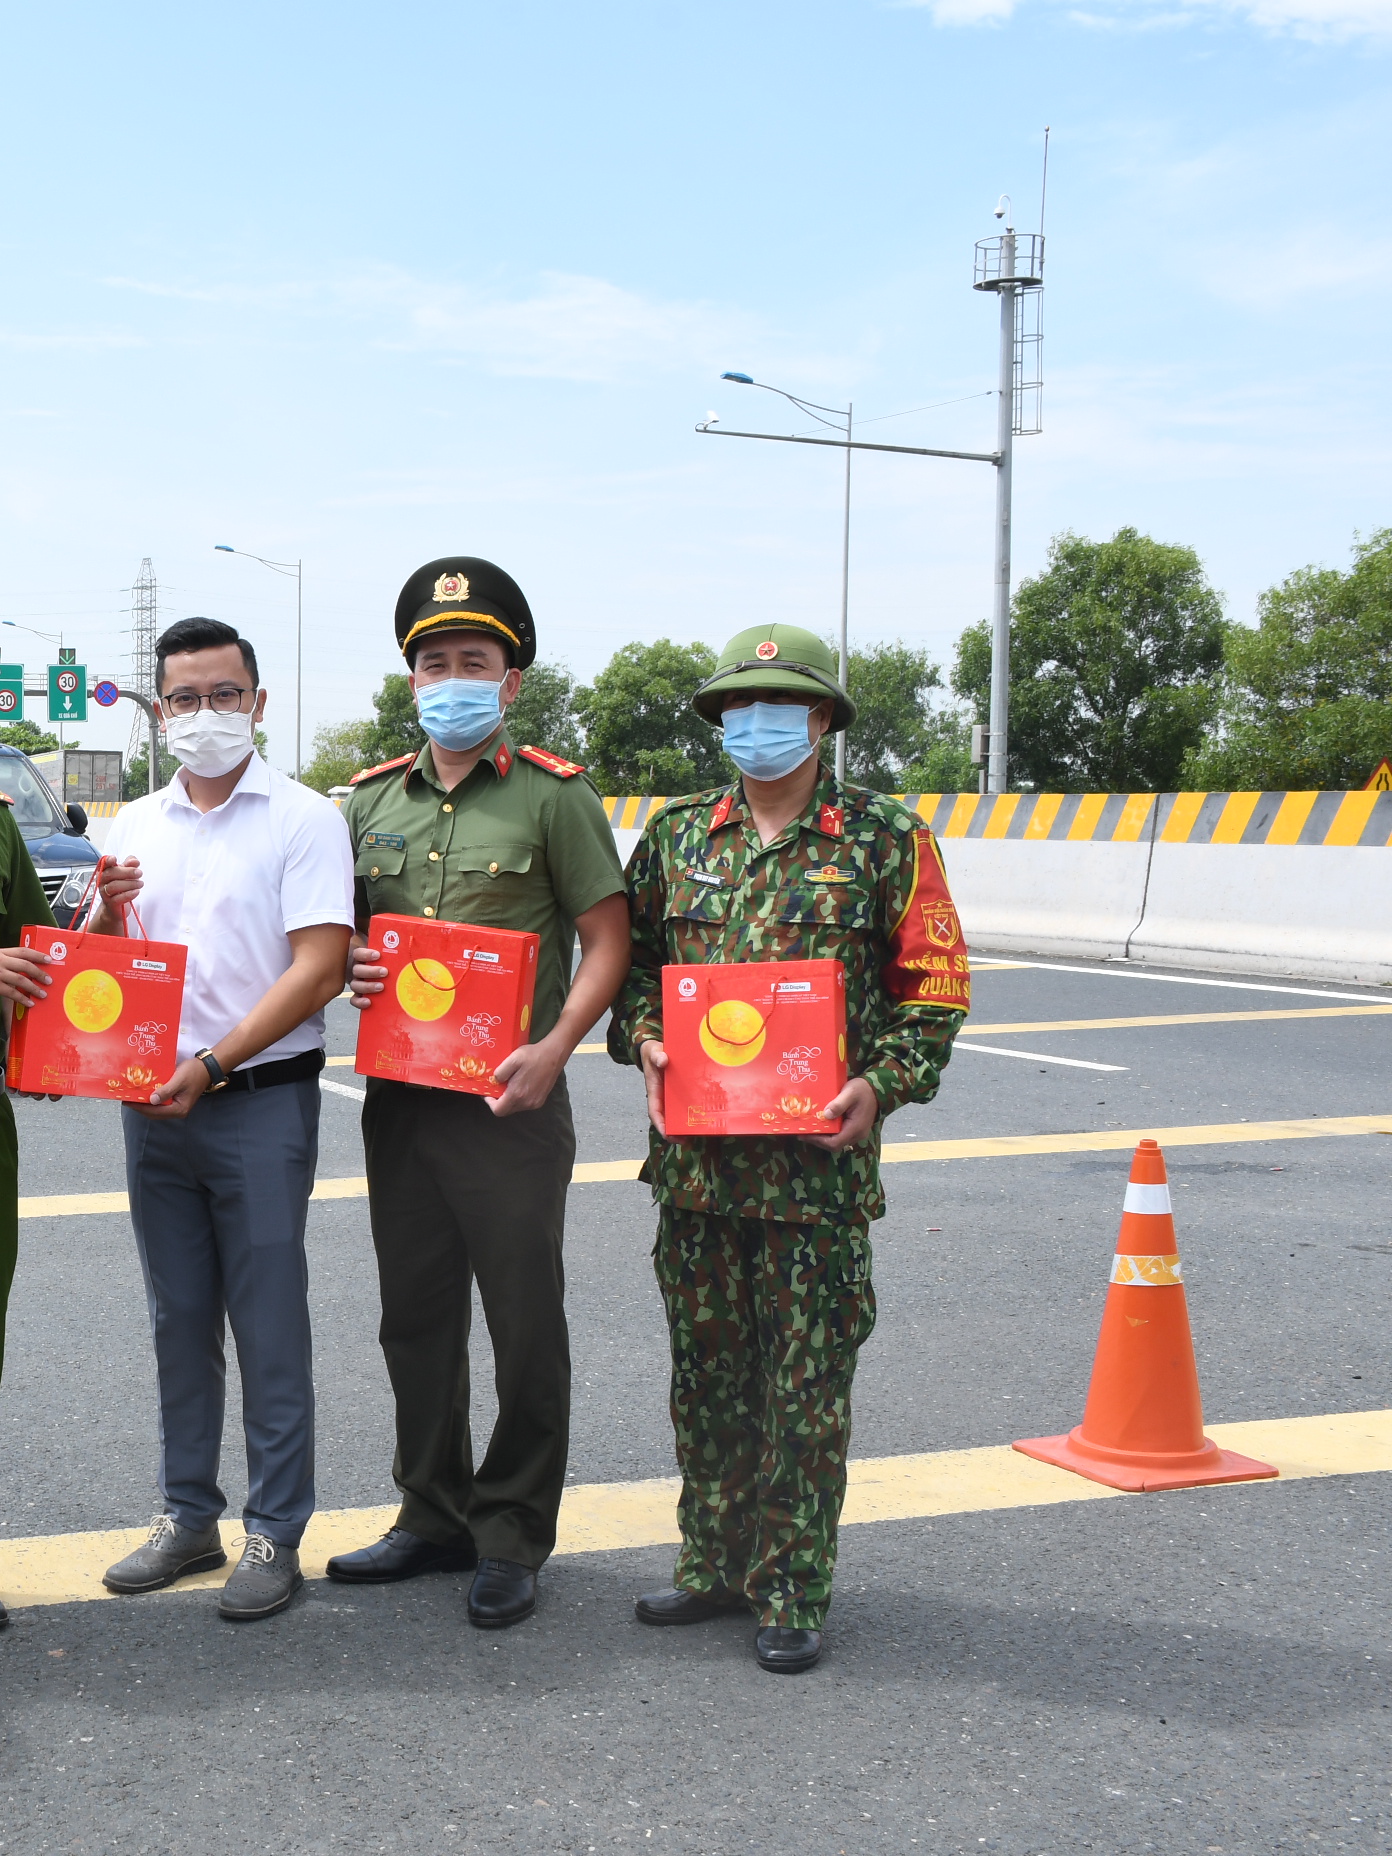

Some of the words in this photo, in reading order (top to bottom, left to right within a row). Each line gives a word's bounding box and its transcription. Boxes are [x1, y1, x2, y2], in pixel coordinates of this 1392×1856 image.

[60, 676, 74, 688] 30
[472, 1023, 489, 1033] Trung
[139, 1032, 156, 1042] Trung
